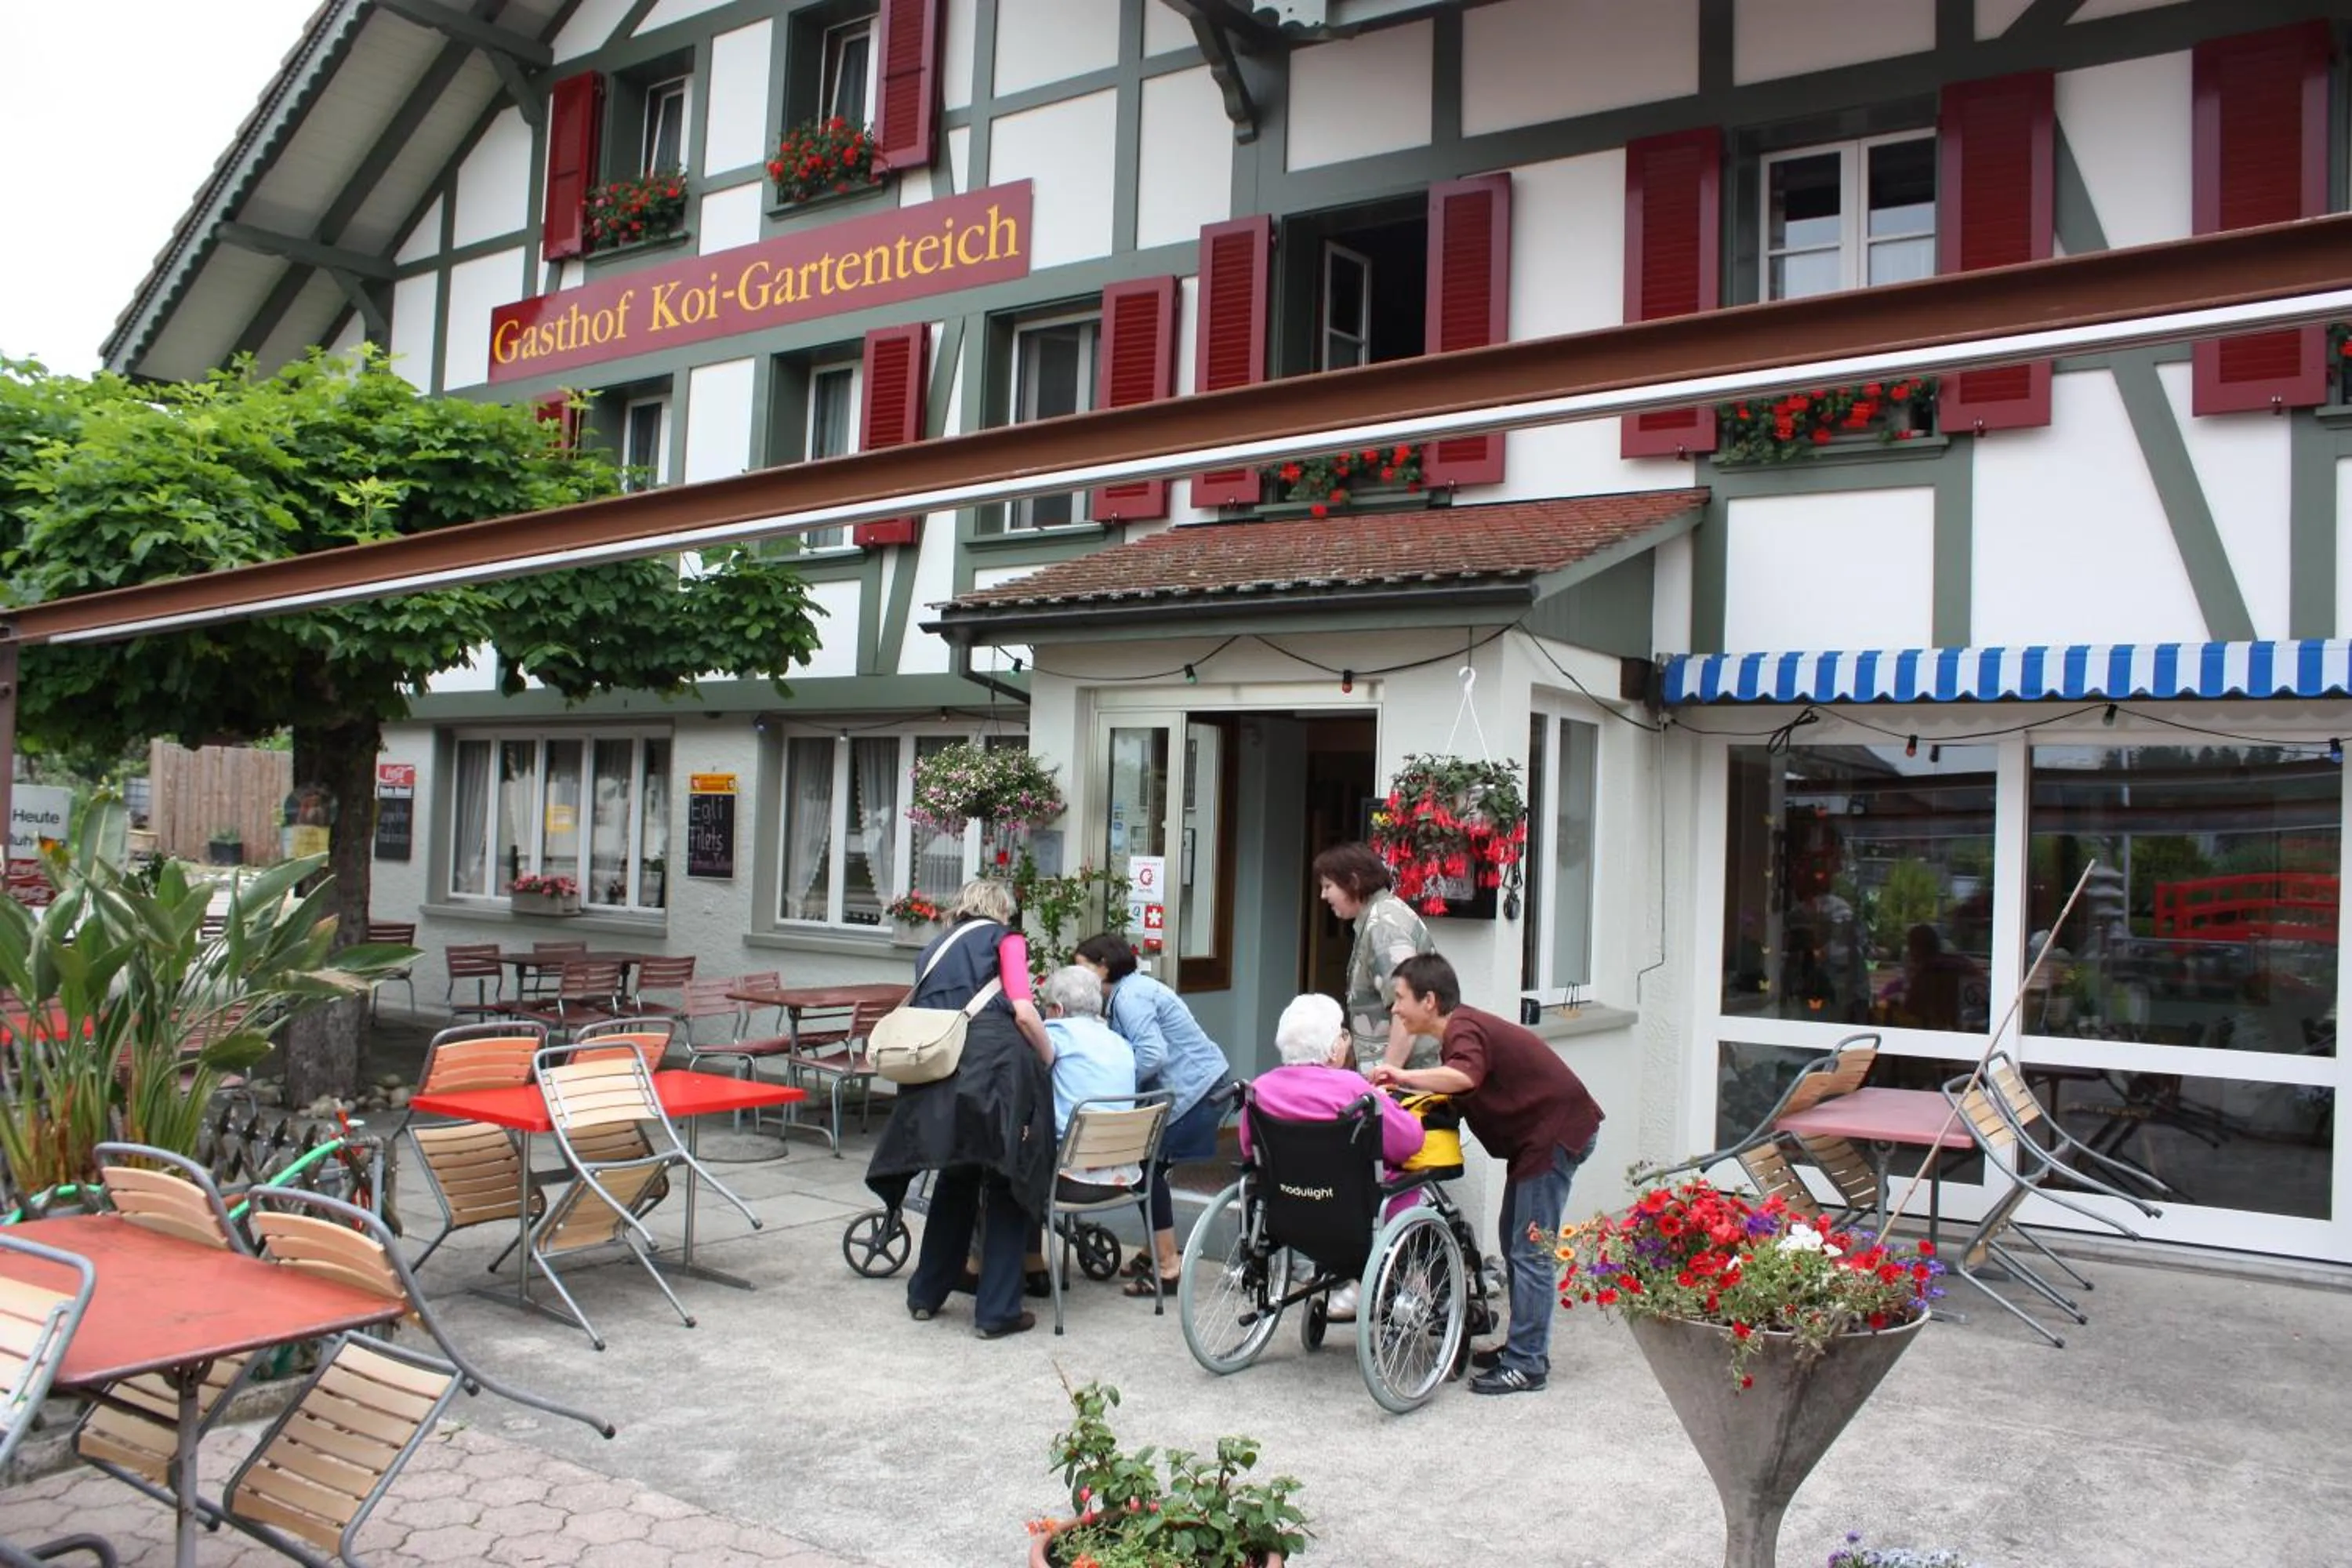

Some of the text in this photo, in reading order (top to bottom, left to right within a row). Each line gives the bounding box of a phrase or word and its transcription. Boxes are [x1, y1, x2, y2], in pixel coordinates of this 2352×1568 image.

[493, 204, 1020, 365] Gasthof Koi-Gartenteich
[13, 809, 60, 824] Heute
[691, 797, 723, 825] Egli
